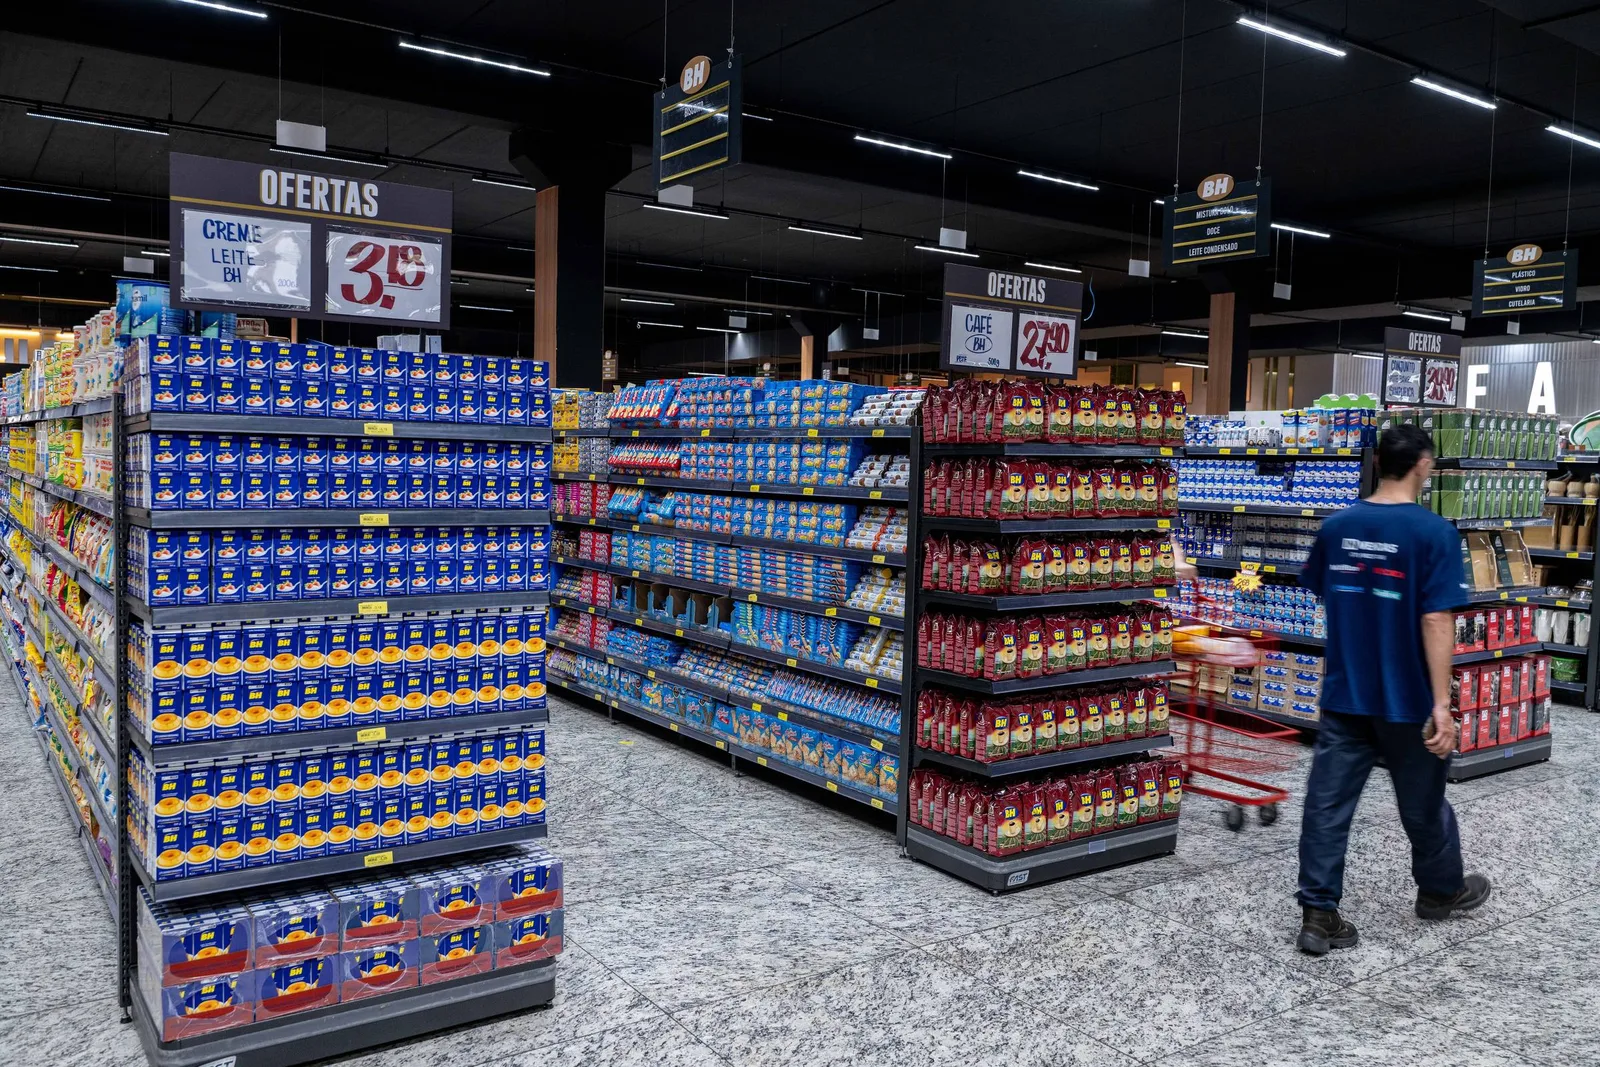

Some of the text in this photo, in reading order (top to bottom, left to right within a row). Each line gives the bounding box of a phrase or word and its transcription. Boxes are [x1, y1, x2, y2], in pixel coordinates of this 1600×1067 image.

[683, 61, 704, 92] BH
[1202, 177, 1228, 197] BH
[260, 169, 378, 218] OFERTAS
[203, 218, 262, 243] CREME
[1207, 226, 1220, 236] DOCE
[1189, 242, 1238, 256] LEITE CONDENSADO
[1511, 247, 1537, 262] BH
[224, 266, 241, 283] BH
[1512, 269, 1536, 278] PLÁSTICO
[988, 272, 1046, 303] OFERTAS
[1508, 299, 1535, 307] CUTELARIA
[966, 313, 992, 334] CAFÉ
[973, 337, 985, 351] BH
[1408, 332, 1441, 353] OFERTAS
[1013, 398, 1022, 406] BH
[1080, 400, 1091, 408] BH
[1160, 544, 1172, 552] BH
[1031, 552, 1041, 561] BH
[1073, 630, 1083, 638] BH
[1091, 626, 1102, 634] BH
[1089, 706, 1098, 714] BH
[995, 719, 1006, 728] BH
[1145, 782, 1155, 790] BH
[1169, 779, 1180, 788] BH
[1101, 790, 1112, 799] BH
[1005, 809, 1015, 818] BH
[193, 830, 206, 839] BH
